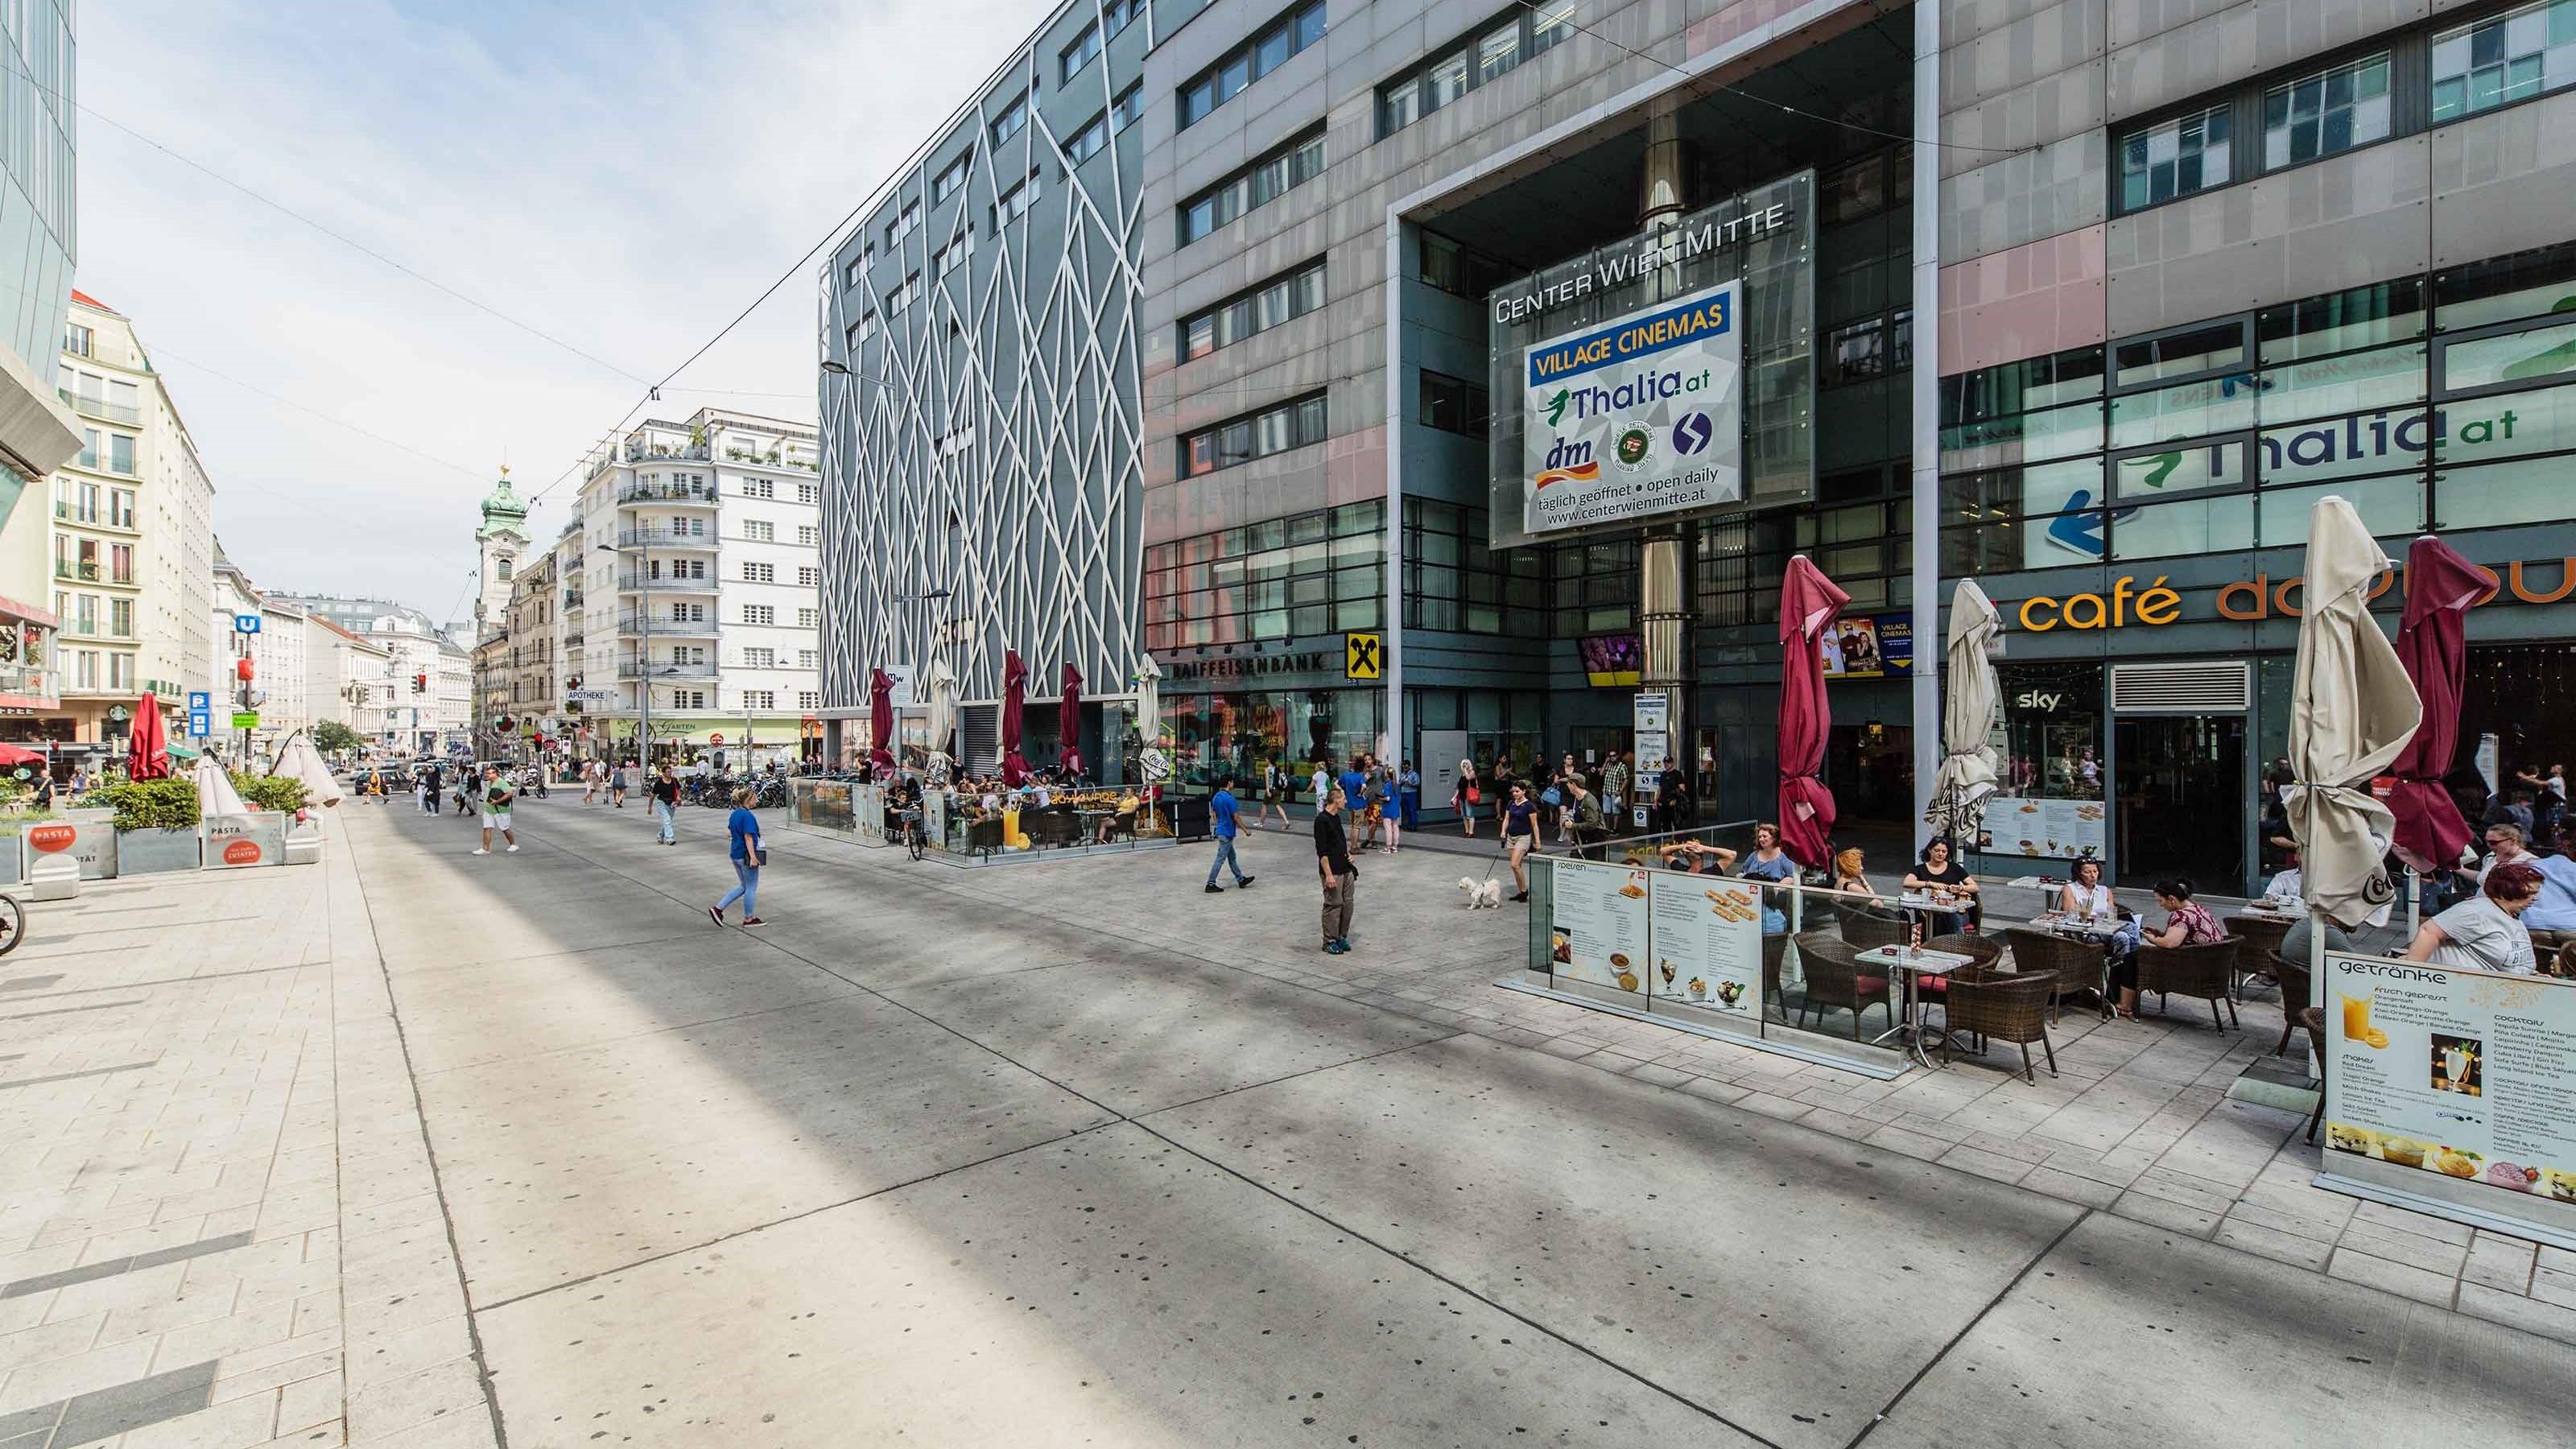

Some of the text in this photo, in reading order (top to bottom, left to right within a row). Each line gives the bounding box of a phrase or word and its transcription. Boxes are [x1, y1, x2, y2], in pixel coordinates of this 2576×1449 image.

[1496, 203, 1784, 324] CENTER WIEN MITTE
[1536, 303, 1723, 377] VILLAGE CINEMAS
[1546, 436, 1591, 471] dm
[1538, 468, 1719, 513] täglich geöffnet open daily
[1547, 488, 1706, 526] www.centerwienmitte.at
[2019, 575, 2182, 632] café
[240, 618, 255, 630] U
[1880, 623, 1908, 631] VILLAGE
[1880, 630, 1912, 638] CINEMAS
[1173, 653, 1323, 679] RAIFFEISENBANK
[568, 691, 605, 700] APOTHEKE
[2019, 690, 2062, 712] sky
[34, 829, 72, 839] PASTA
[2339, 961, 2446, 985] getränke
